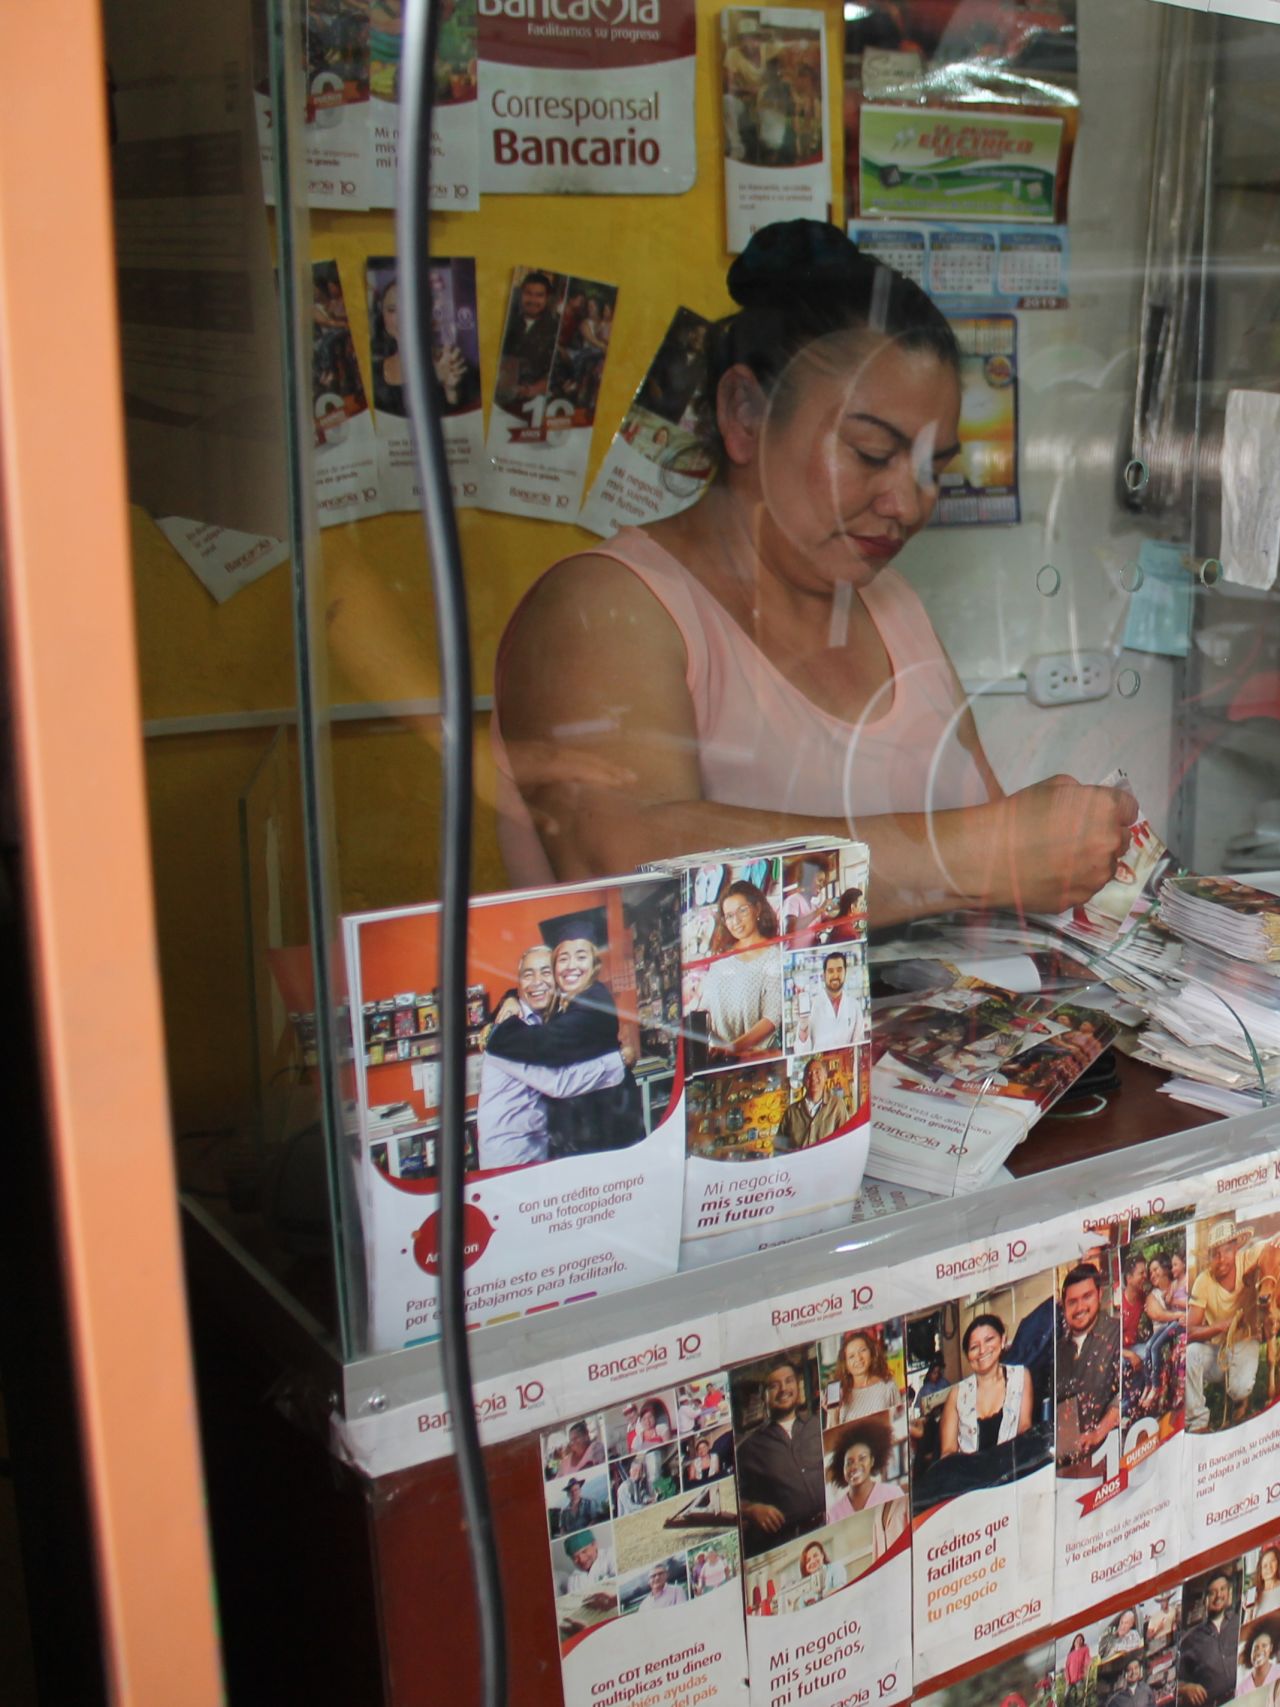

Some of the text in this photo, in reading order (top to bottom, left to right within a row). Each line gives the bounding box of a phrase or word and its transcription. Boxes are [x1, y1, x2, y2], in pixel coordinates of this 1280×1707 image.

[528, 22, 661, 42] Facilitamos su progreso
[492, 89, 659, 126] Corresponsal
[375, 127, 389, 139] Mi
[493, 127, 660, 166] Bancario
[375, 143, 396, 154] mis
[518, 1174, 645, 1214] Con un crédito compró
[704, 1170, 791, 1197] Mi negocio,
[531, 1192, 633, 1225] una fotocopiadora
[701, 1185, 797, 1213] mis sueños,
[1147, 1197, 1166, 1216] 10
[548, 1208, 615, 1234] más grande
[697, 1204, 775, 1229] mi futuro
[1007, 1240, 1027, 1265] 10
[406, 1251, 615, 1313] Para esto es progreso,
[405, 1263, 628, 1331] por rabajamos para facilitarlo.
[851, 1286, 873, 1311] 10
[676, 1334, 701, 1361] 10
[516, 1380, 544, 1410] 10
[1126, 1438, 1158, 1466] DUEÑOS
[1198, 1462, 1208, 1472] En
[1209, 1445, 1247, 1469] Bancamía,
[1249, 1440, 1257, 1449] su
[1197, 1475, 1207, 1485] se
[1208, 1464, 1235, 1483] adapta
[1241, 1458, 1250, 1467] su
[1094, 1479, 1121, 1502] AÑOS
[1196, 1484, 1215, 1498] rural
[1105, 1523, 1121, 1539] está
[1122, 1517, 1131, 1529] de
[1133, 1499, 1170, 1524] aniversario
[927, 1515, 1010, 1562] Créditos que
[1072, 1519, 1150, 1562] lo celebra en grande
[1149, 1539, 1166, 1560] 10
[927, 1538, 997, 1583] facilitan el
[927, 1556, 1006, 1607] progreso de
[927, 1581, 998, 1624] tu negocio
[769, 1619, 862, 1671] Mi negocio,
[590, 1643, 705, 1696] Con CDT Rentamía
[592, 1675, 664, 1707] multiplicas
[667, 1667, 680, 1682] tu
[683, 1651, 722, 1675] dinero
[770, 1639, 866, 1691] mis sueños,
[663, 1675, 708, 1699] ayudas
[693, 1684, 718, 1704] país
[771, 1689, 792, 1707] mi
[797, 1667, 847, 1700] futuro
[877, 1673, 897, 1698] 10
